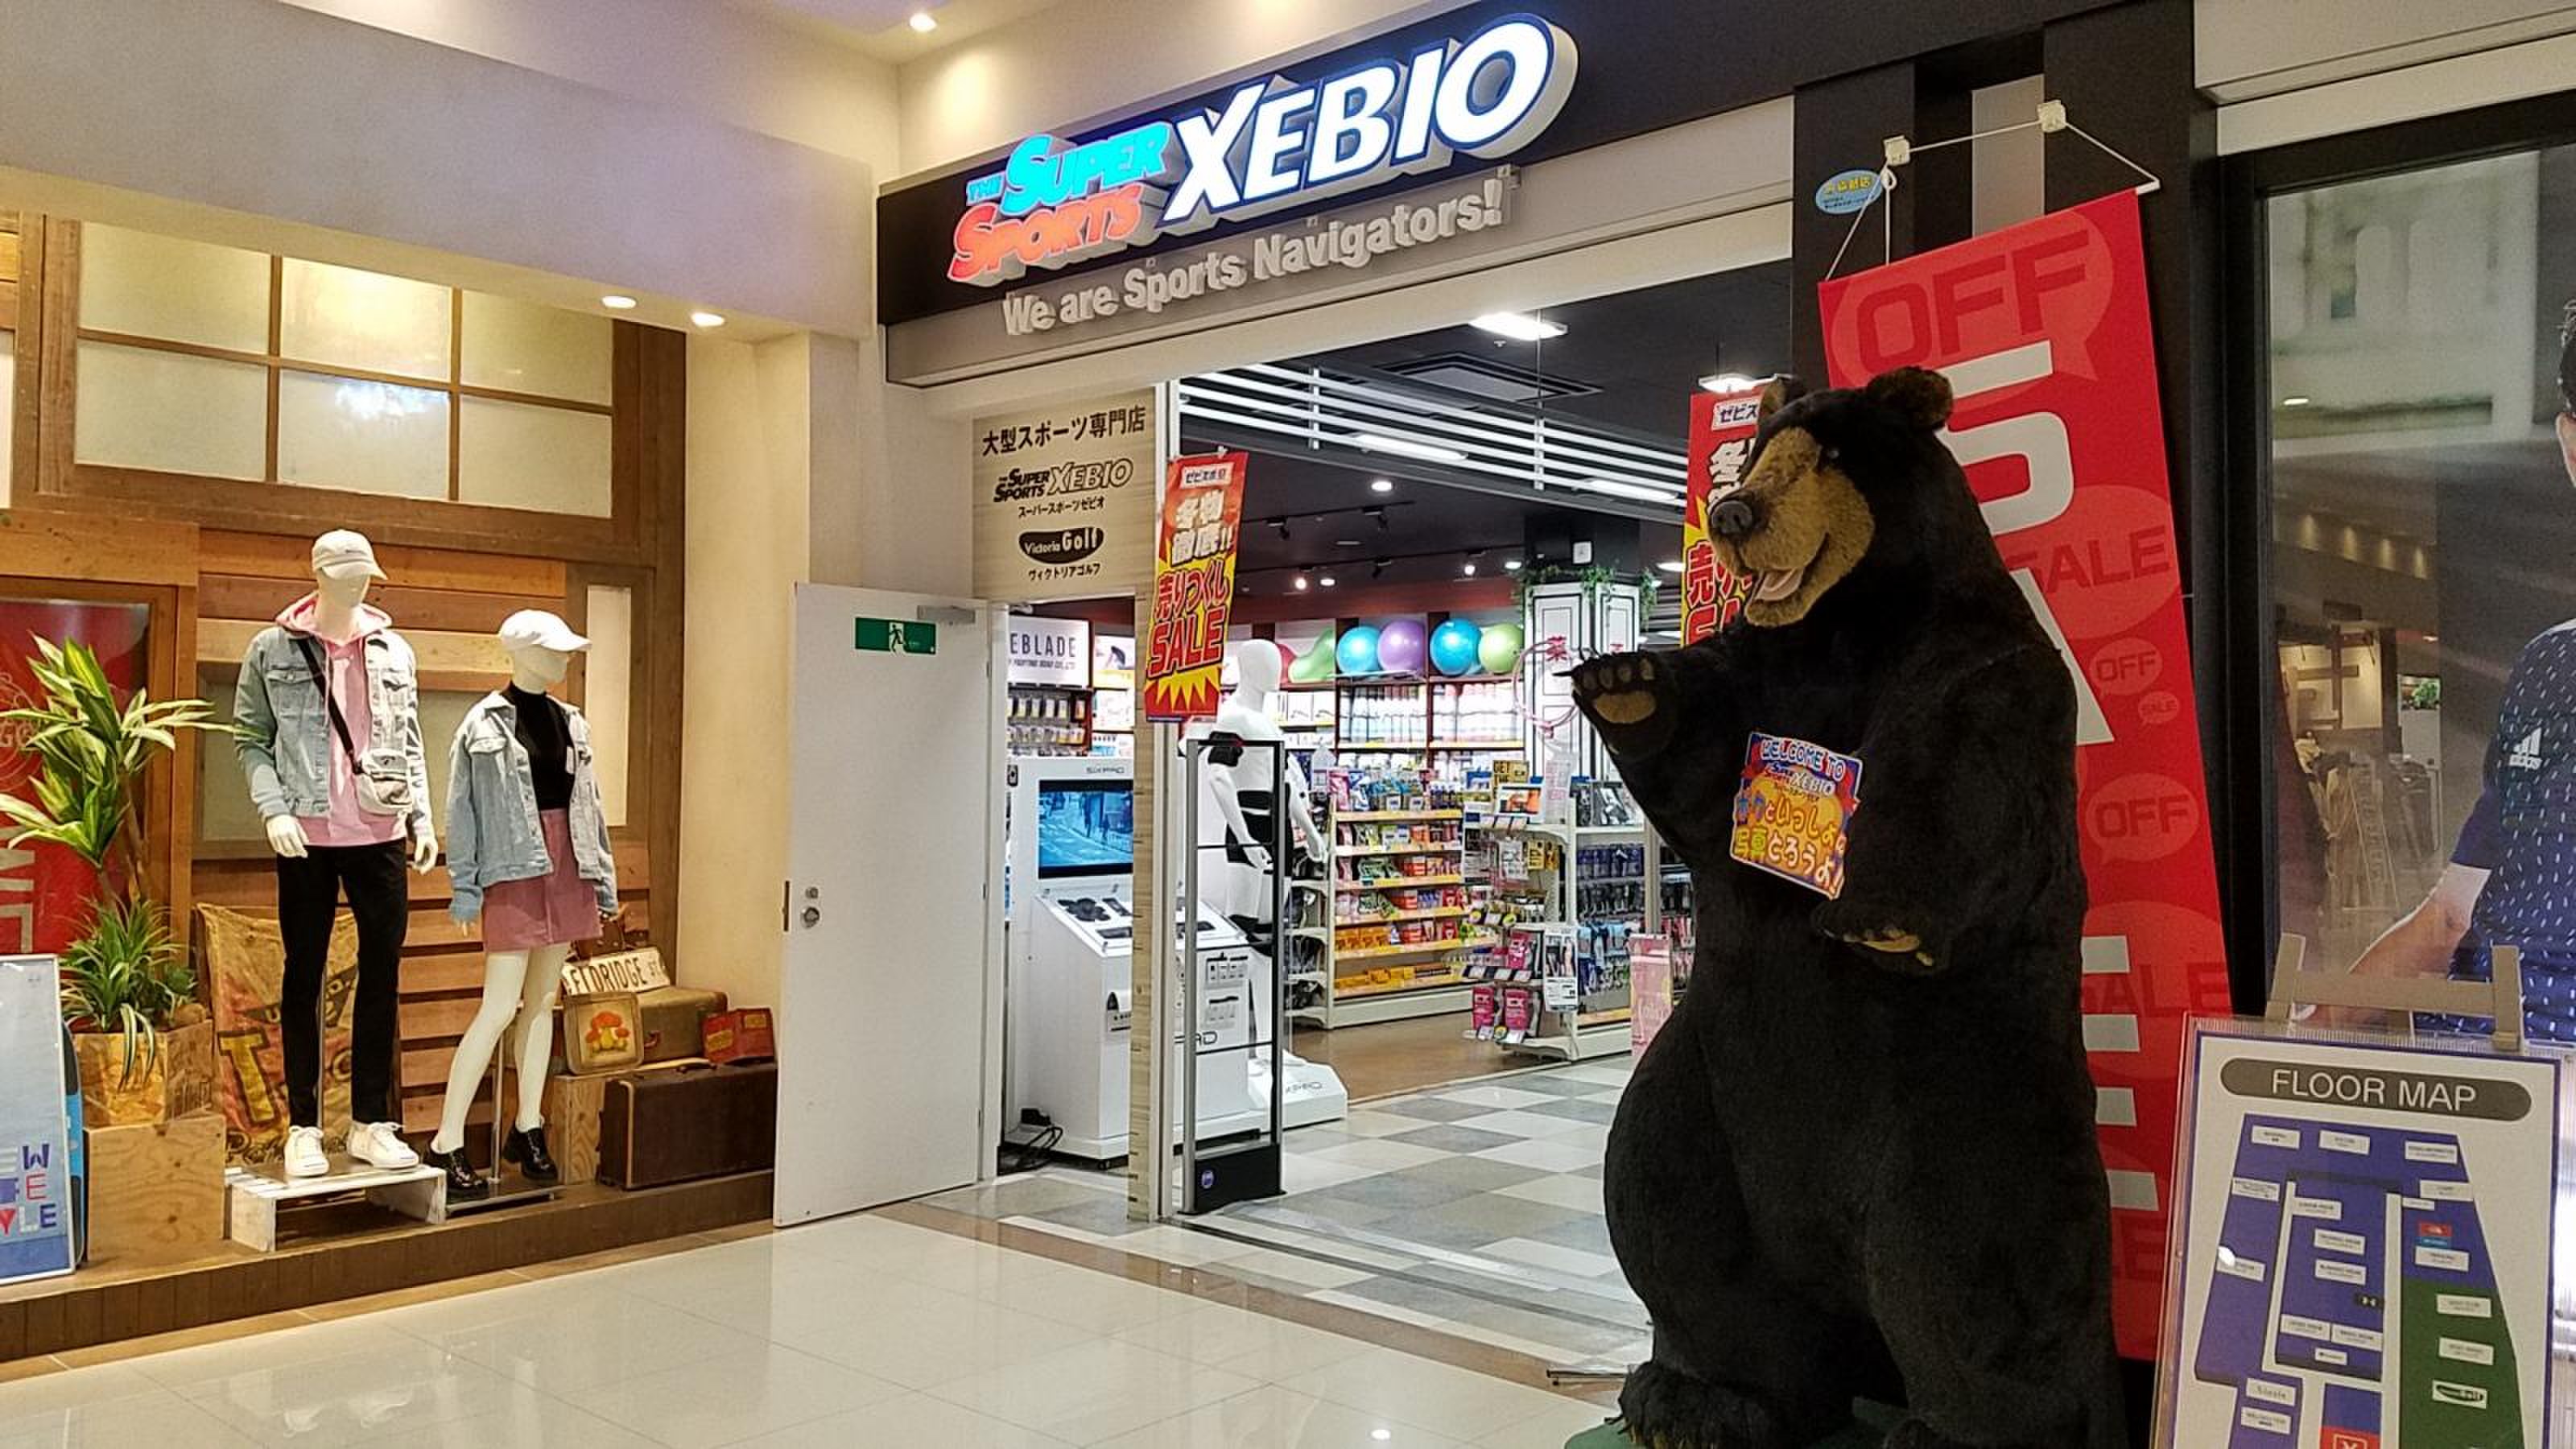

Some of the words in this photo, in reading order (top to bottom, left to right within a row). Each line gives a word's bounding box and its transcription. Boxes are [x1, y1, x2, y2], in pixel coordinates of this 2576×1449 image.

[1000, 122, 1170, 214] SUPER
[1162, 18, 1554, 223] XEBIO
[947, 182, 1143, 280] SPORTS
[1004, 291, 1056, 336] We
[1059, 282, 1119, 324] are
[1125, 251, 1247, 313] Sports
[1253, 180, 1505, 282] Navigators!
[1858, 232, 2090, 371] OFF
[981, 405, 1146, 456] 大型スポーツ専門店
[993, 484, 1046, 503] SPORTS
[1008, 468, 1050, 487] SUPER
[1047, 458, 1134, 496] XEBIO
[1024, 541, 1061, 555] Victoria
[1062, 527, 1098, 551] Golf
[1147, 605, 1226, 680] SALE
[2095, 650, 2157, 682] OFF
[2095, 793, 2190, 839] OFF
[2083, 961, 2233, 1018] ALE
[2272, 1069, 2385, 1104] FLOOR
[2398, 1079, 2477, 1112] MAP
